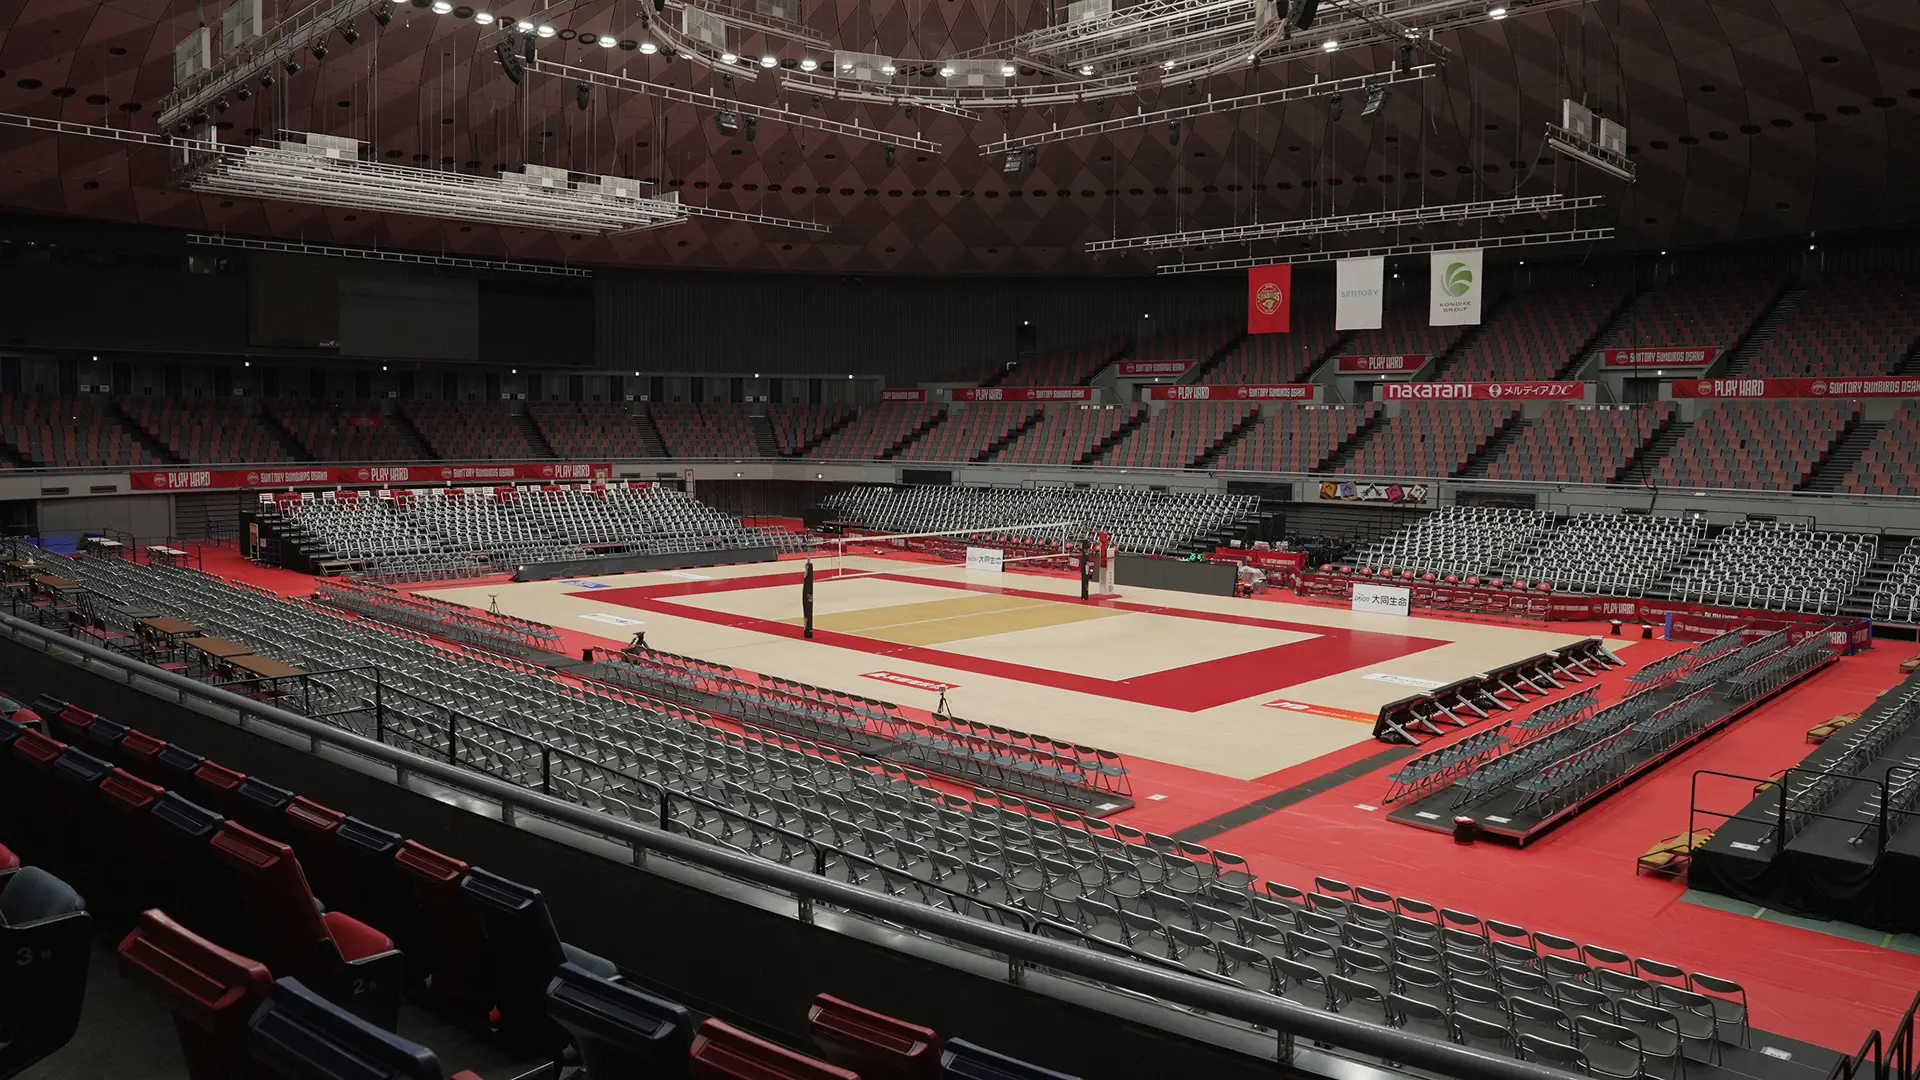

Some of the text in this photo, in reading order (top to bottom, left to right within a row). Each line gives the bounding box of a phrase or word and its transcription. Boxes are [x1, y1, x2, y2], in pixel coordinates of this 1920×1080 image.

[1341, 289, 1379, 298] SUNTORY
[1369, 356, 1385, 369] PLAY
[1714, 380, 1764, 396] PLAY HARD
[1829, 381, 1862, 394] SUNTORY
[1863, 380, 1900, 393] SUNBIRDS
[371, 467, 409, 481] PLAY HARD
[555, 464, 571, 478] PLAY
[168, 471, 211, 488] PLAY HARD
[1371, 594, 1408, 607] 大同生命
[1603, 602, 1619, 615] PLAY
[1827, 631, 1848, 645] ARD
[16, 946, 34, 966] 3
[353, 978, 364, 996] 2
